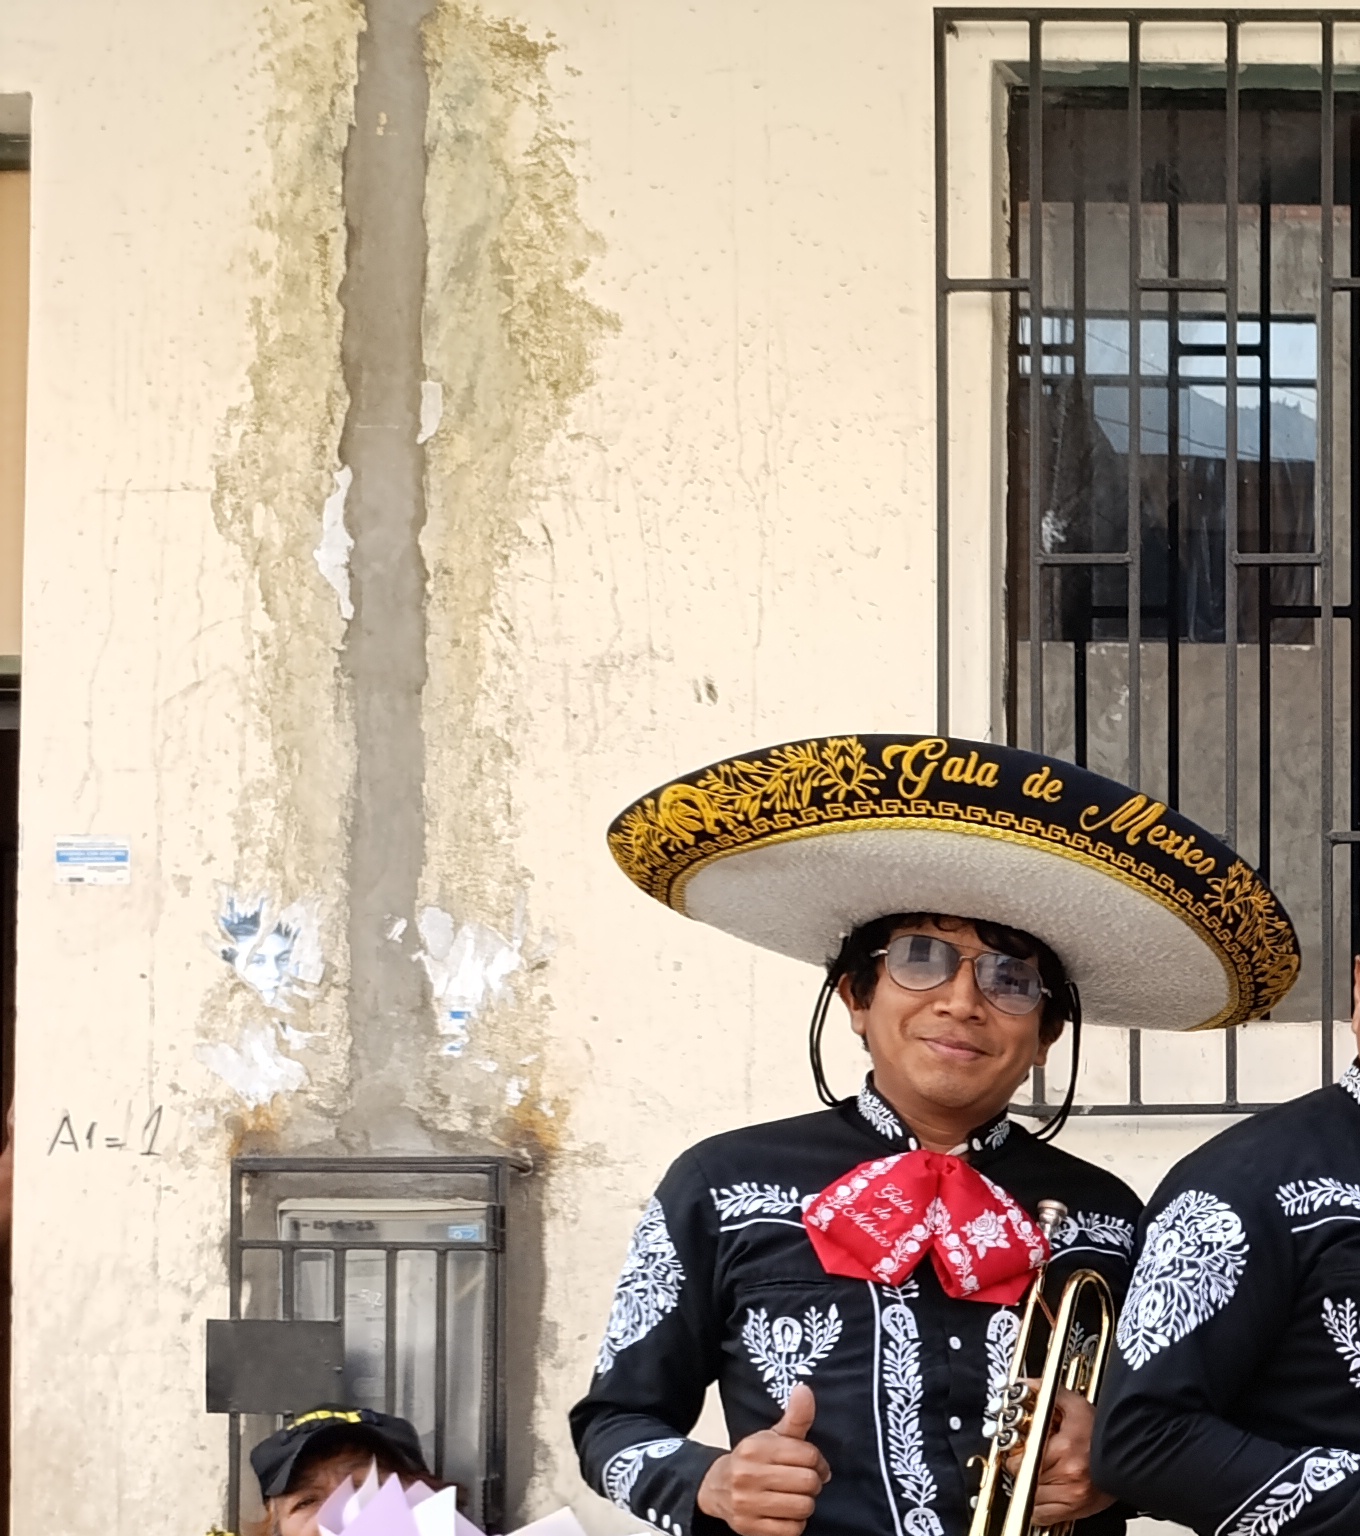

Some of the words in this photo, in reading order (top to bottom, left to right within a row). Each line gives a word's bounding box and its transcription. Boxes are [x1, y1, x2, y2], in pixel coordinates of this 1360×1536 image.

[882, 738, 999, 799] Gala
[1022, 766, 1063, 802] de
[1080, 794, 1215, 875] Mexico
[871, 1206, 893, 1220] de
[873, 1182, 914, 1214] Gala
